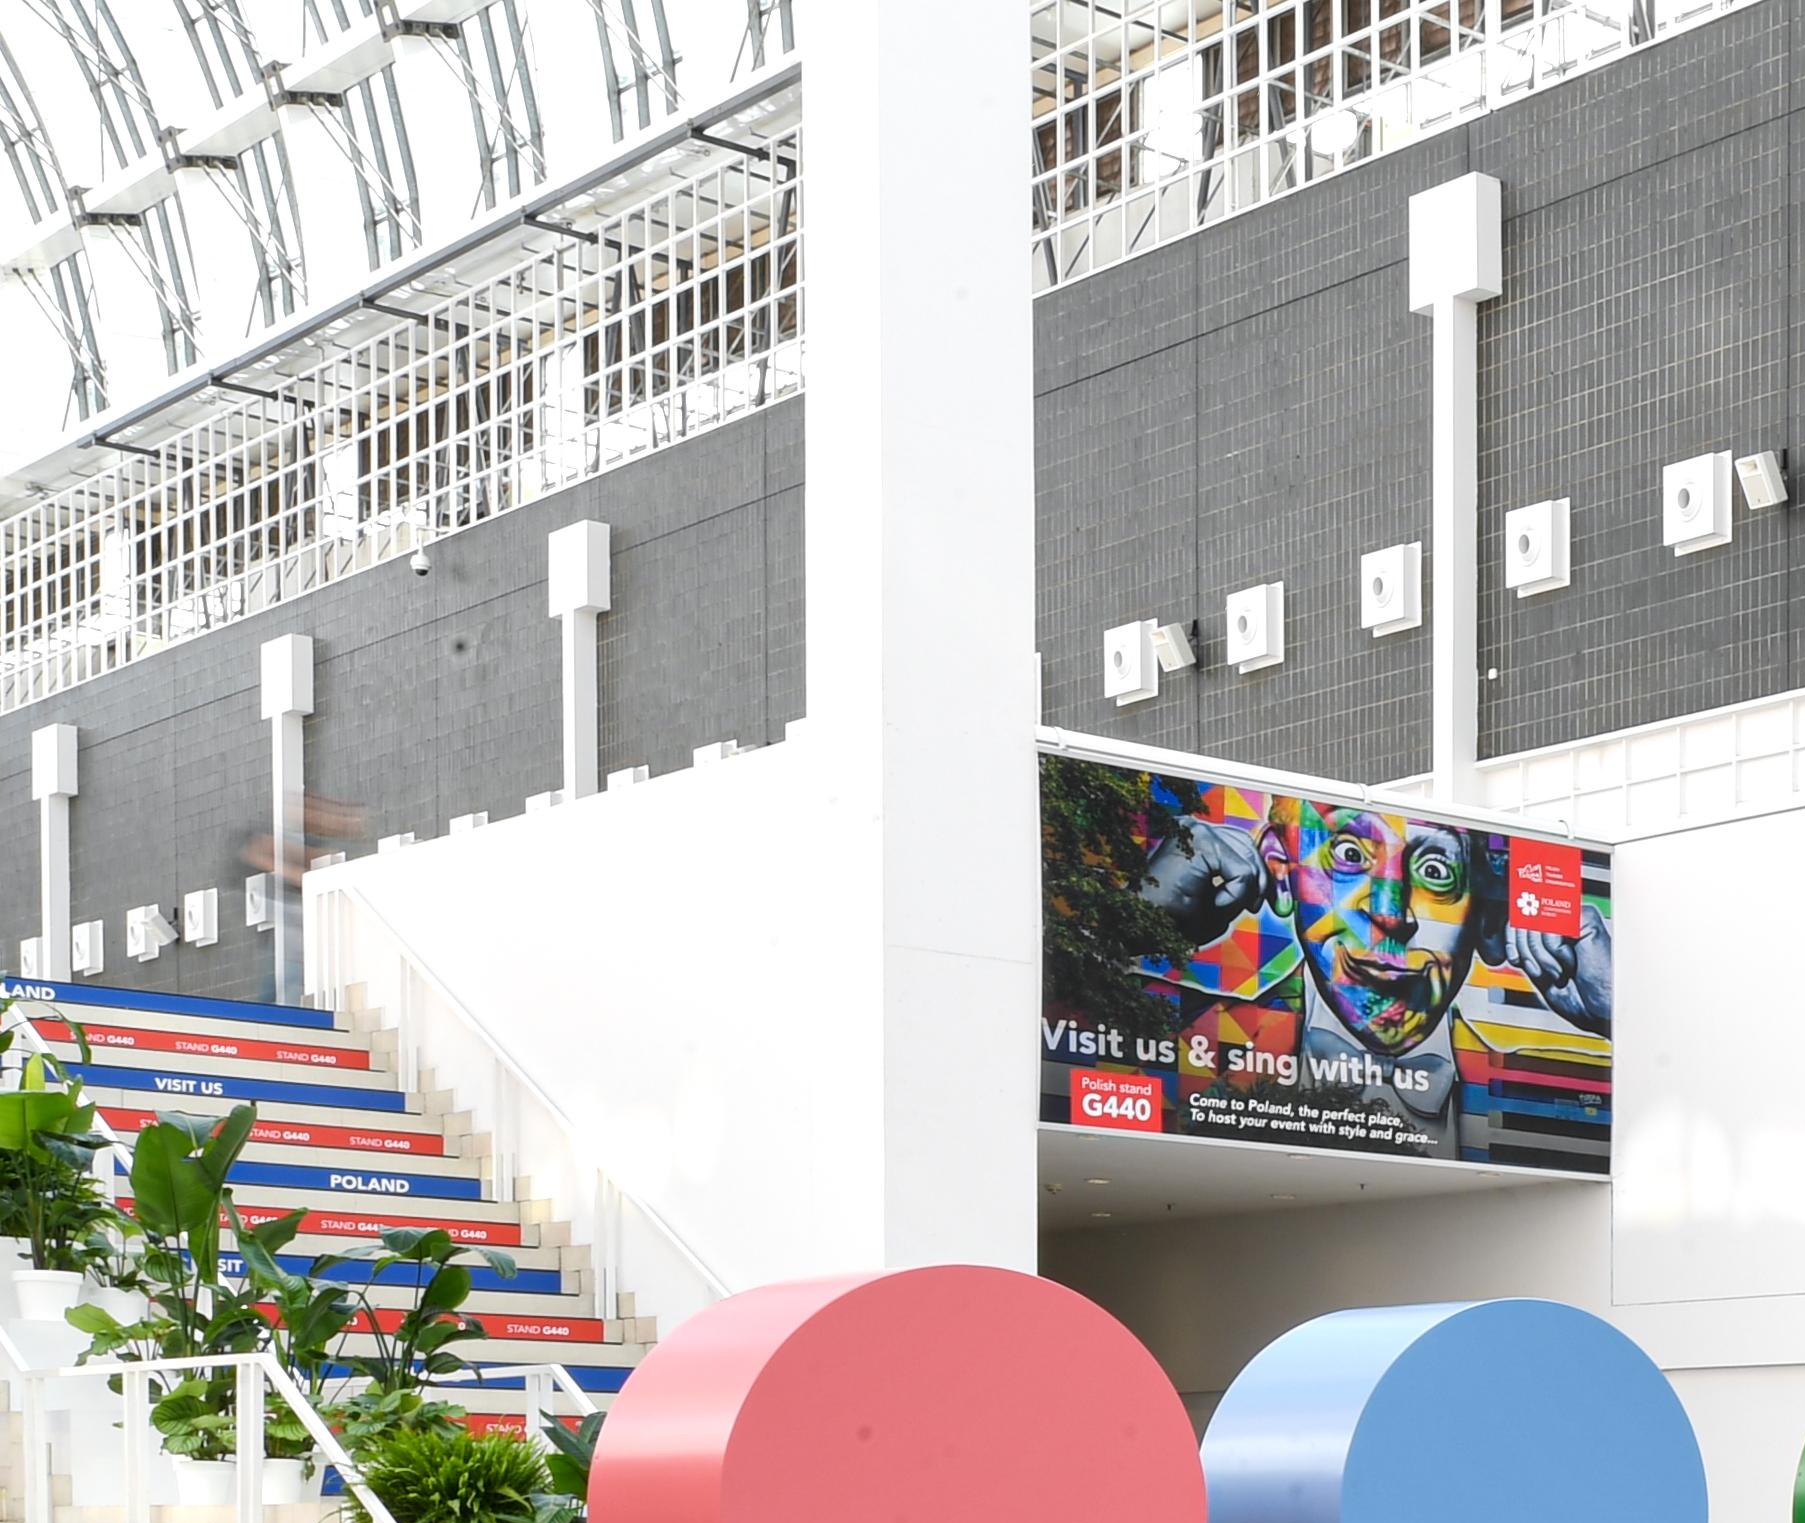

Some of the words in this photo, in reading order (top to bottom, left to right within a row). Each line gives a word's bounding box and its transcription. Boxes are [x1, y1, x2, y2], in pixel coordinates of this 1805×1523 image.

[0, 983, 56, 1000] LAND
[107, 1036, 135, 1046] G440
[175, 1041, 209, 1052] STAND
[211, 1044, 238, 1055] G440
[276, 1050, 309, 1062] STAND
[311, 1054, 337, 1065] G440
[1040, 1017, 1124, 1058] Visit
[1136, 1040, 1175, 1063] us
[1187, 1034, 1217, 1069] &
[1227, 1041, 1299, 1086] sing
[1309, 1053, 1383, 1087] with
[1393, 1065, 1430, 1092] us
[154, 1077, 197, 1093] VISIT
[201, 1081, 224, 1095] US
[1081, 1076, 1117, 1093] Polish
[1120, 1081, 1153, 1096] stand
[1081, 1092, 1152, 1121] G440
[1189, 1093, 1228, 1110] Come
[1231, 1098, 1245, 1111] to
[1248, 1099, 1295, 1118] Poland,
[1298, 1106, 1320, 1119] the
[1322, 1109, 1366, 1126] perfect
[1368, 1113, 1404, 1129] place,
[1190, 1108, 1206, 1122] To
[1208, 1110, 1237, 1124] host
[1239, 1115, 1268, 1130] your
[1270, 1118, 1307, 1132] event
[1309, 1121, 1336, 1136] with
[1338, 1124, 1368, 1141] style
[1369, 1127, 1393, 1141] and
[283, 1130, 310, 1142] G440
[349, 1136, 382, 1147] STAND
[384, 1140, 411, 1150] G440
[330, 1174, 410, 1194] POLAND
[321, 1219, 356, 1231] STAND
[217, 1259, 244, 1273] SIT
[506, 1324, 541, 1335] STAND
[542, 1326, 570, 1336] G440
